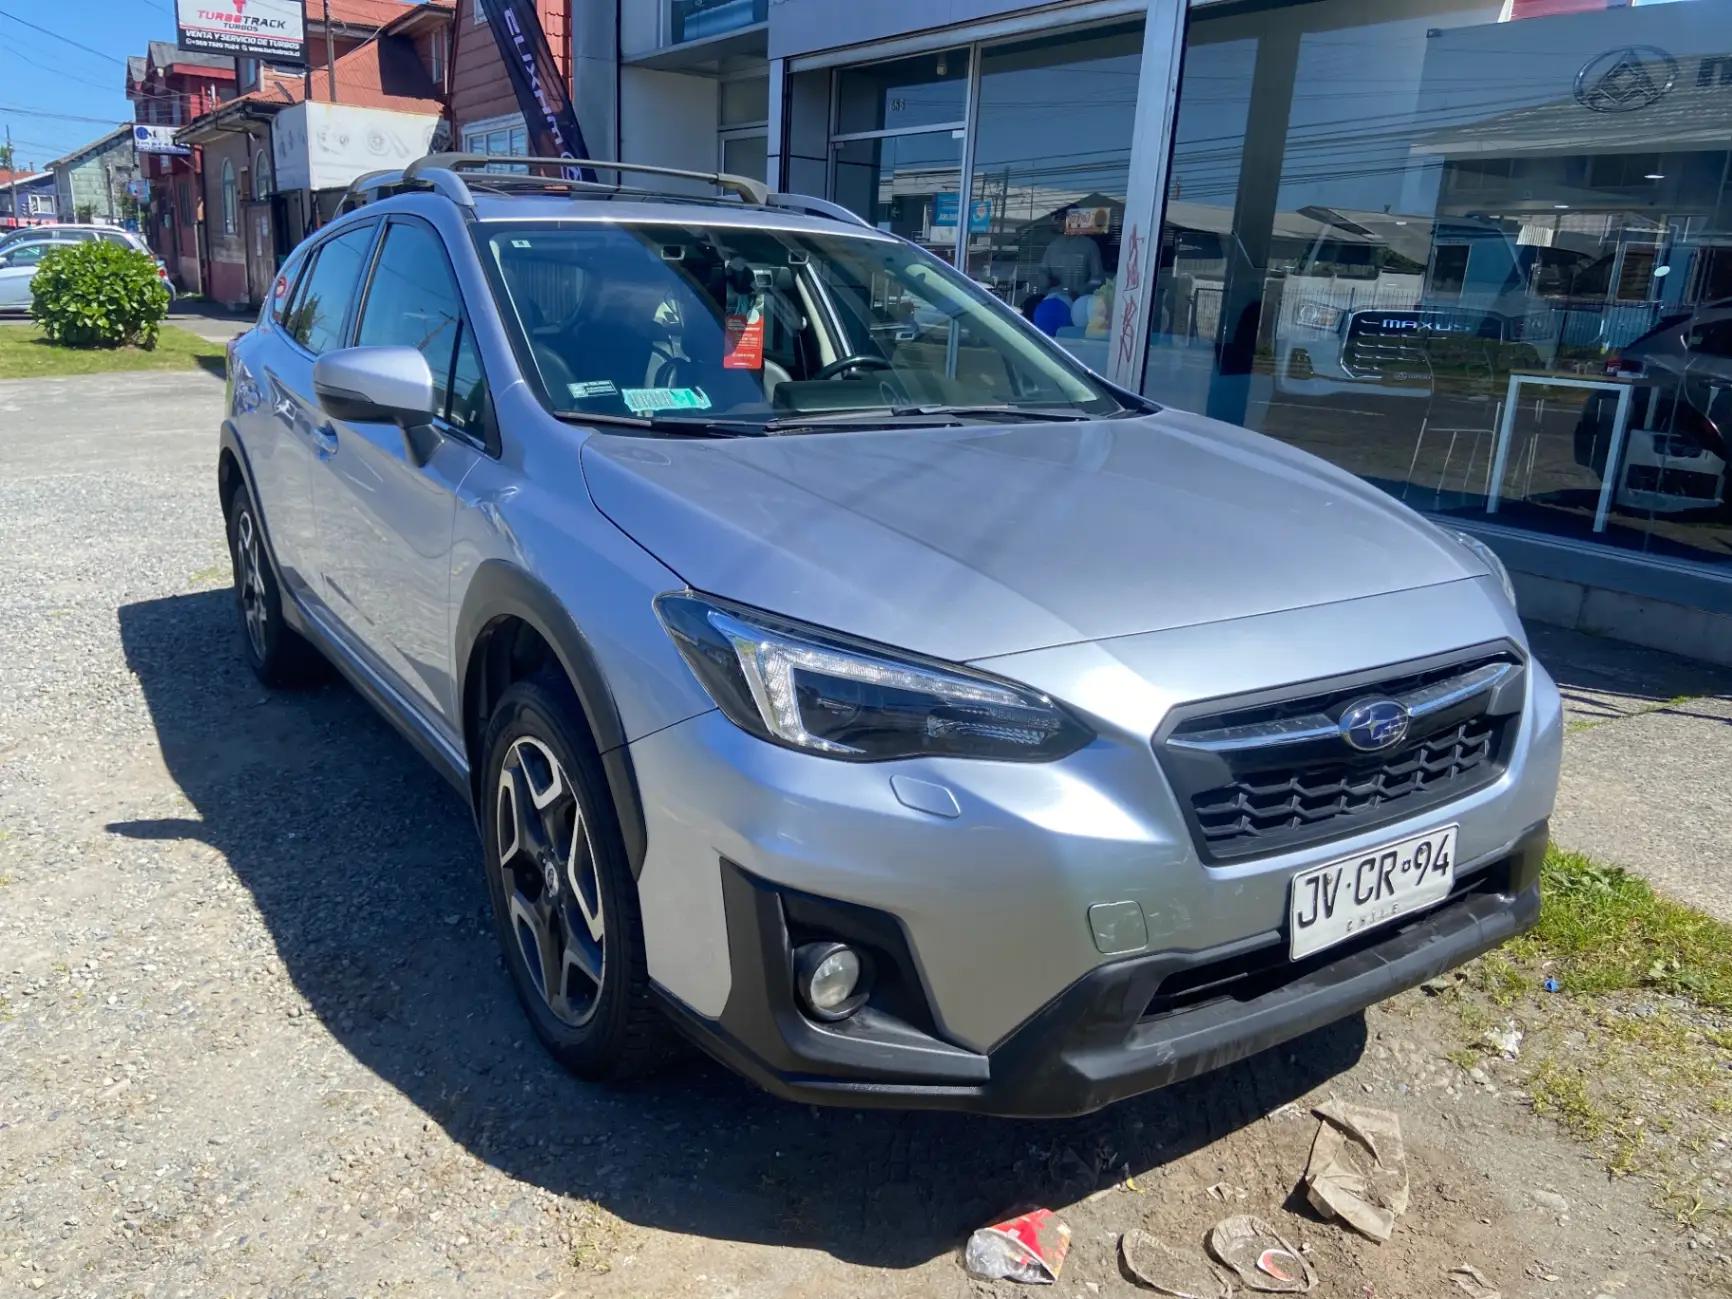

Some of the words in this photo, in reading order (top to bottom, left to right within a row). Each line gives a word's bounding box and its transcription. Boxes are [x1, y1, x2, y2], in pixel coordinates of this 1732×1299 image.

[223, 22, 259, 32] TURBOS
[185, 30, 213, 40] VENTA
[212, 33, 221, 41] Y
[220, 34, 256, 45] SERVICIO
[256, 38, 268, 46] DE
[268, 39, 300, 50] TURBOS
[1382, 318, 1471, 332] MAXUS
[1346, 903, 1399, 931] CHILE
